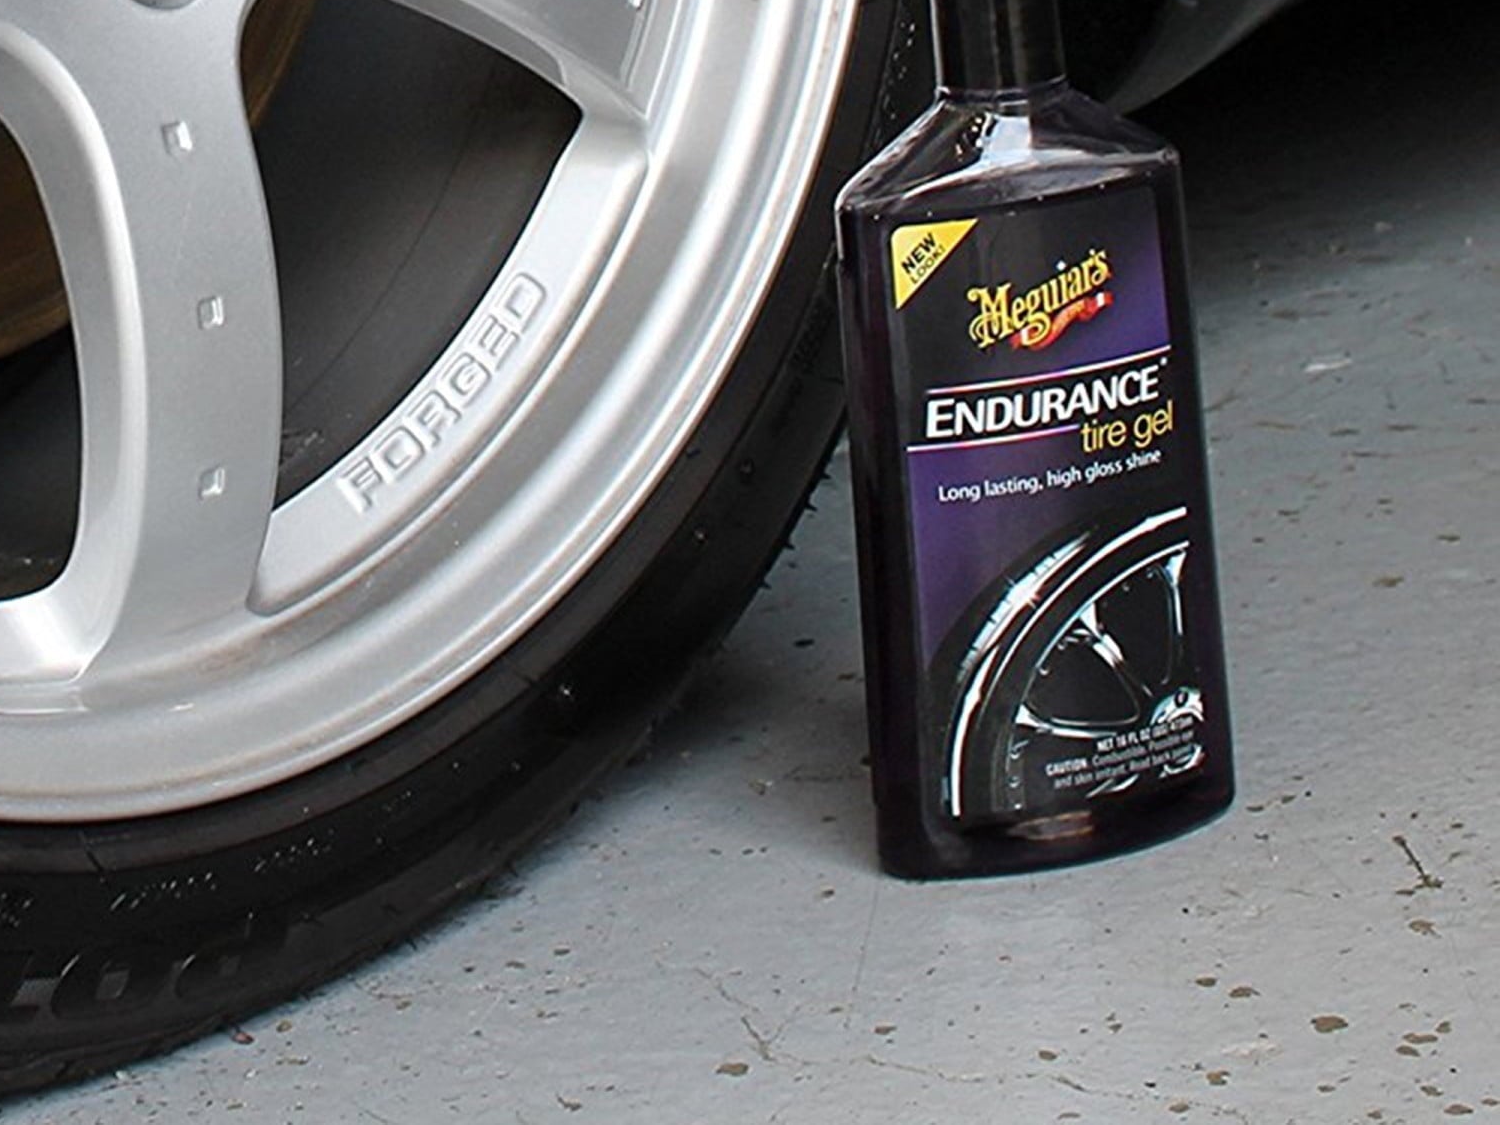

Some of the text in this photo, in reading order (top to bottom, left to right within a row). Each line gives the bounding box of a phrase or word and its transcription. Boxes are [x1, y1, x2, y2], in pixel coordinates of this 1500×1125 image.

[901, 233, 935, 274] NEW
[966, 249, 1111, 349] Meguiar's
[337, 272, 546, 513] FORGED
[926, 365, 1159, 438] ENDURANCE
[1081, 400, 1173, 453] tire gel
[938, 449, 1162, 503] Long lasting, high gloss shine
